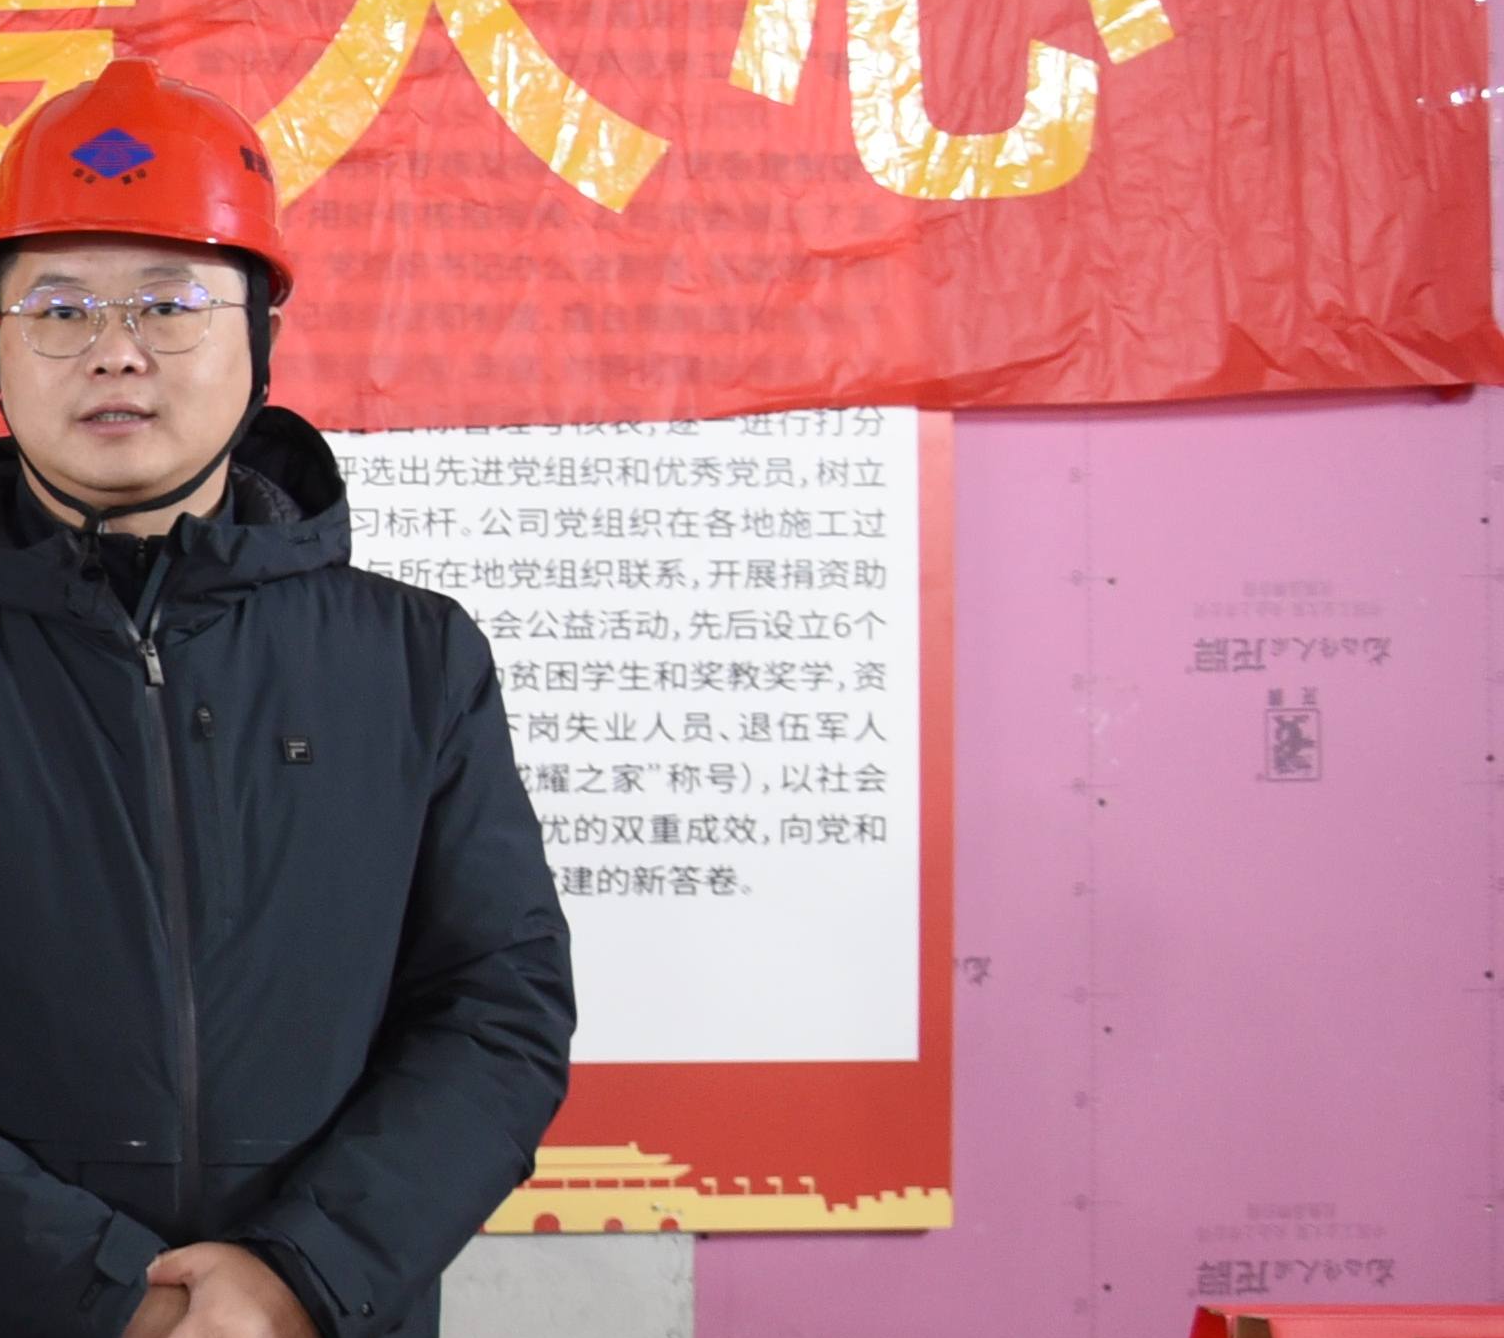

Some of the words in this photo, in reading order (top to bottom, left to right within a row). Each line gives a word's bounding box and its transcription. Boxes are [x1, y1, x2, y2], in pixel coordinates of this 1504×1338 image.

[483, 609, 887, 643] 会公益活动，先后设立6个
[501, 661, 887, 696] 贫困学生和奖教奖学，资
[550, 865, 754, 899] 建的新答卷。
